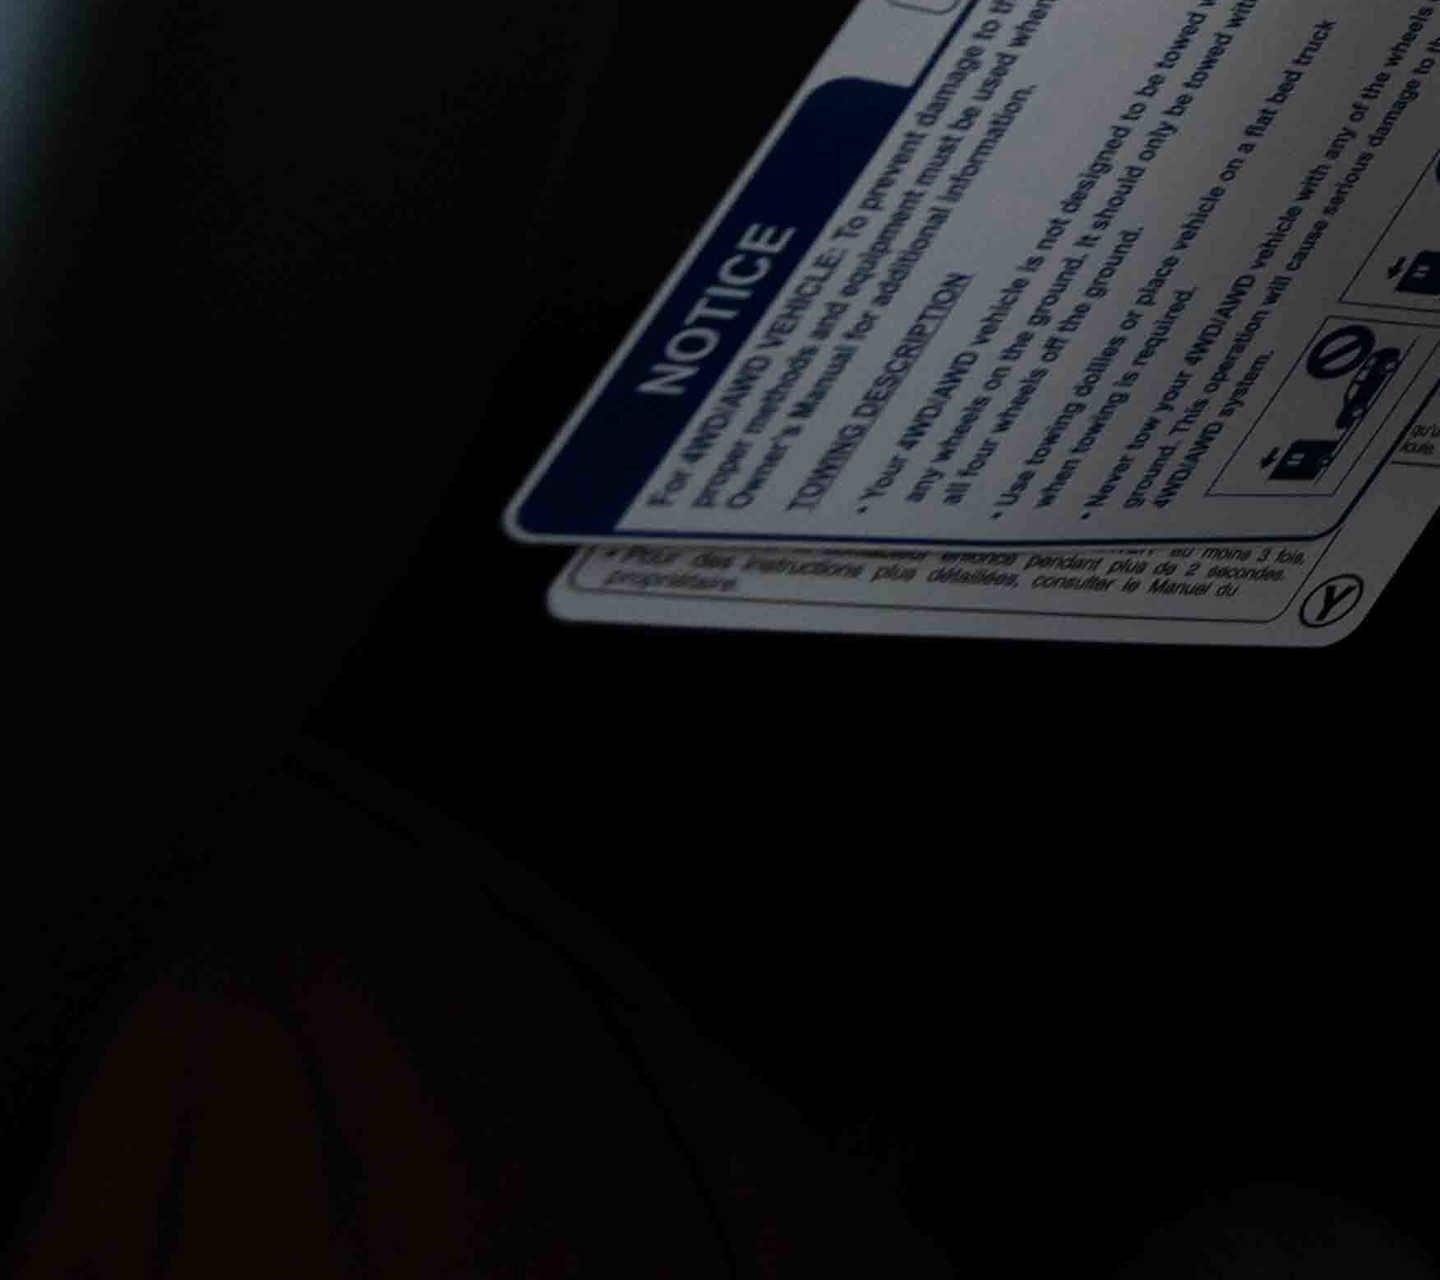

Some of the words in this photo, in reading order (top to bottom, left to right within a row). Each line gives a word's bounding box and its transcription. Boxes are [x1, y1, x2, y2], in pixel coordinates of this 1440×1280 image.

[638, 223, 796, 394] NOTICE
[646, 470, 692, 507] For
[681, 355, 772, 464] 4WD/AWD
[831, 216, 868, 240] To
[858, 130, 929, 211] prevent
[915, 45, 985, 128] damage
[972, 19, 1002, 41] to
[1083, 454, 1135, 507] Never
[1125, 416, 1161, 451] tow
[1151, 369, 1193, 413] your
[1183, 274, 1257, 367] 4WD/AWD
[1249, 205, 1303, 270] vehicle
[1295, 164, 1332, 202] with
[1324, 126, 1358, 161] any
[1349, 101, 1370, 123] of
[1360, 71, 1391, 100] the
[1383, 6, 1435, 68] wheels
[1025, 553, 1103, 572] pendant
[1106, 558, 1148, 574] plus
[1152, 561, 1176, 576] de
[1183, 562, 1197, 577] 2
[1315, 583, 1356, 622] Y
